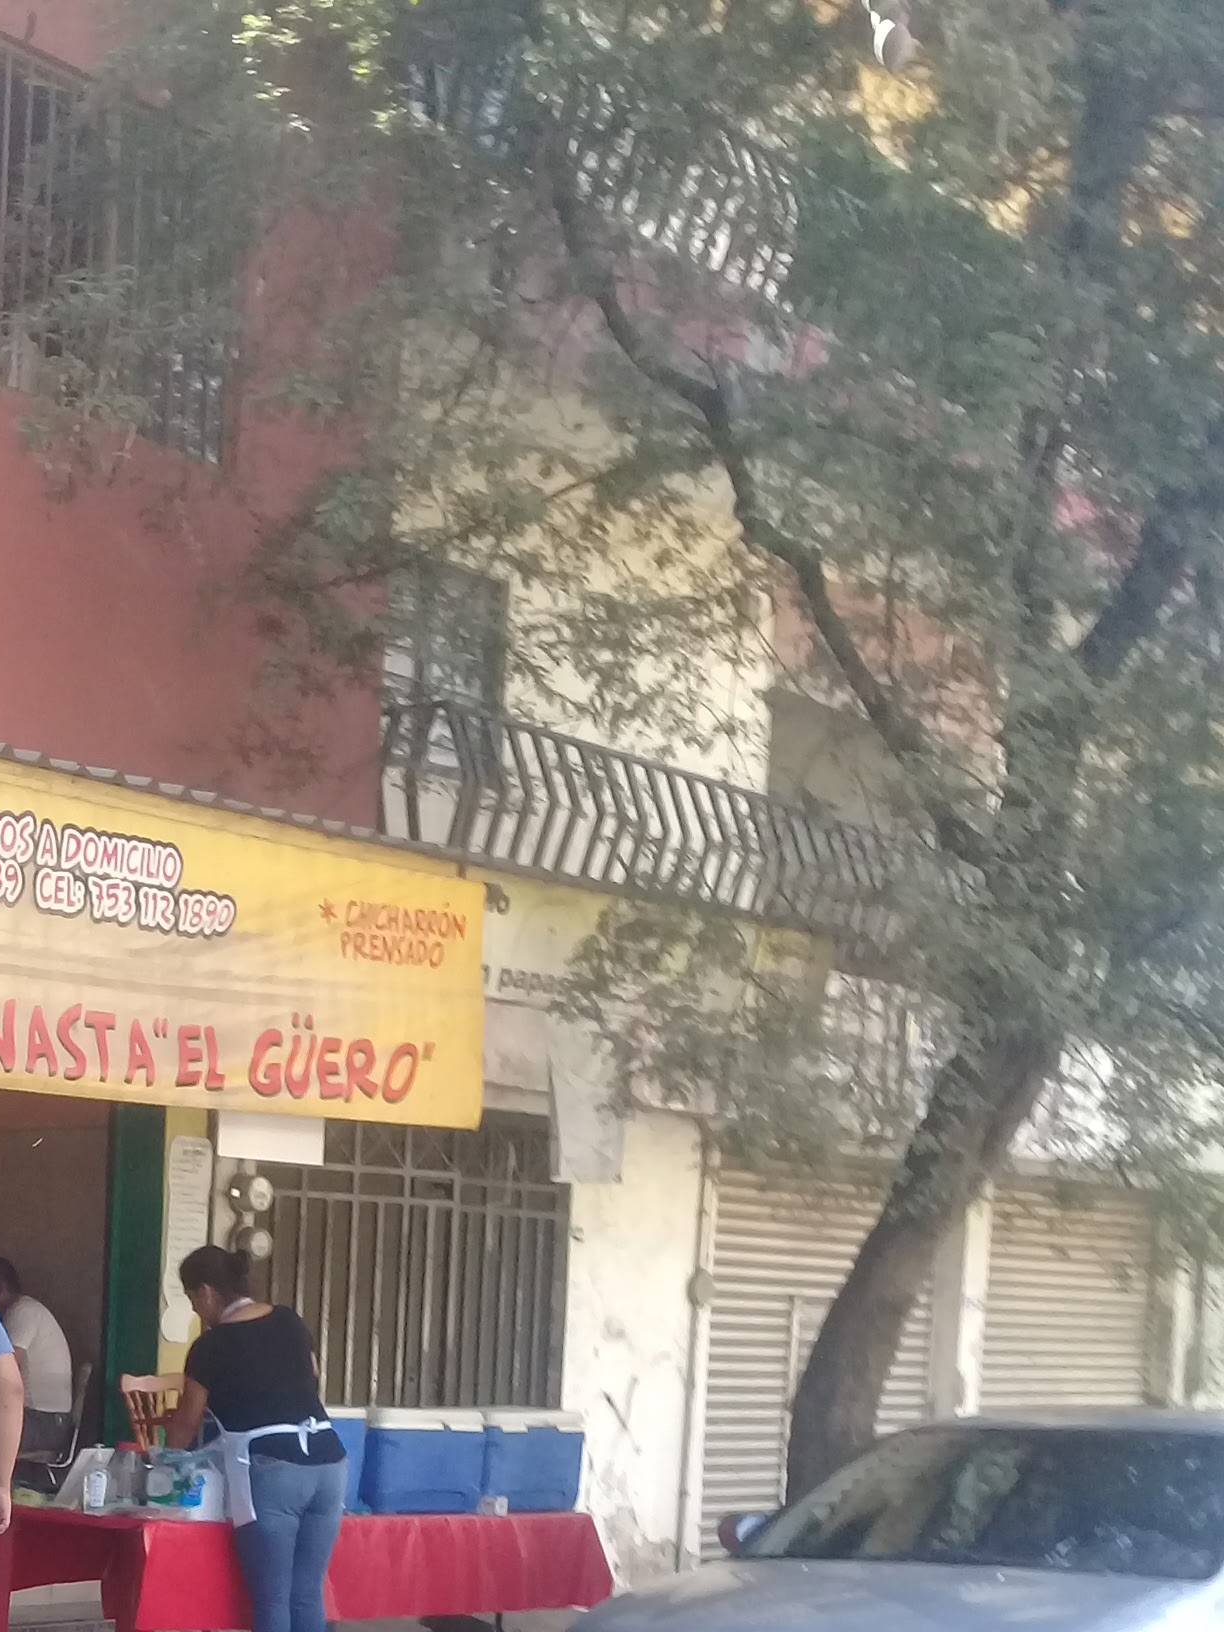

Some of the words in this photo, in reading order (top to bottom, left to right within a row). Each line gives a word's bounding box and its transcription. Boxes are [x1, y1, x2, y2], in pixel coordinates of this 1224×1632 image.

[36, 822, 58, 867] A
[61, 828, 181, 888] DOMICILIO
[36, 867, 85, 913] CEL:
[89, 876, 136, 923] 753
[139, 886, 175, 930] 112
[178, 893, 235, 935] 1890
